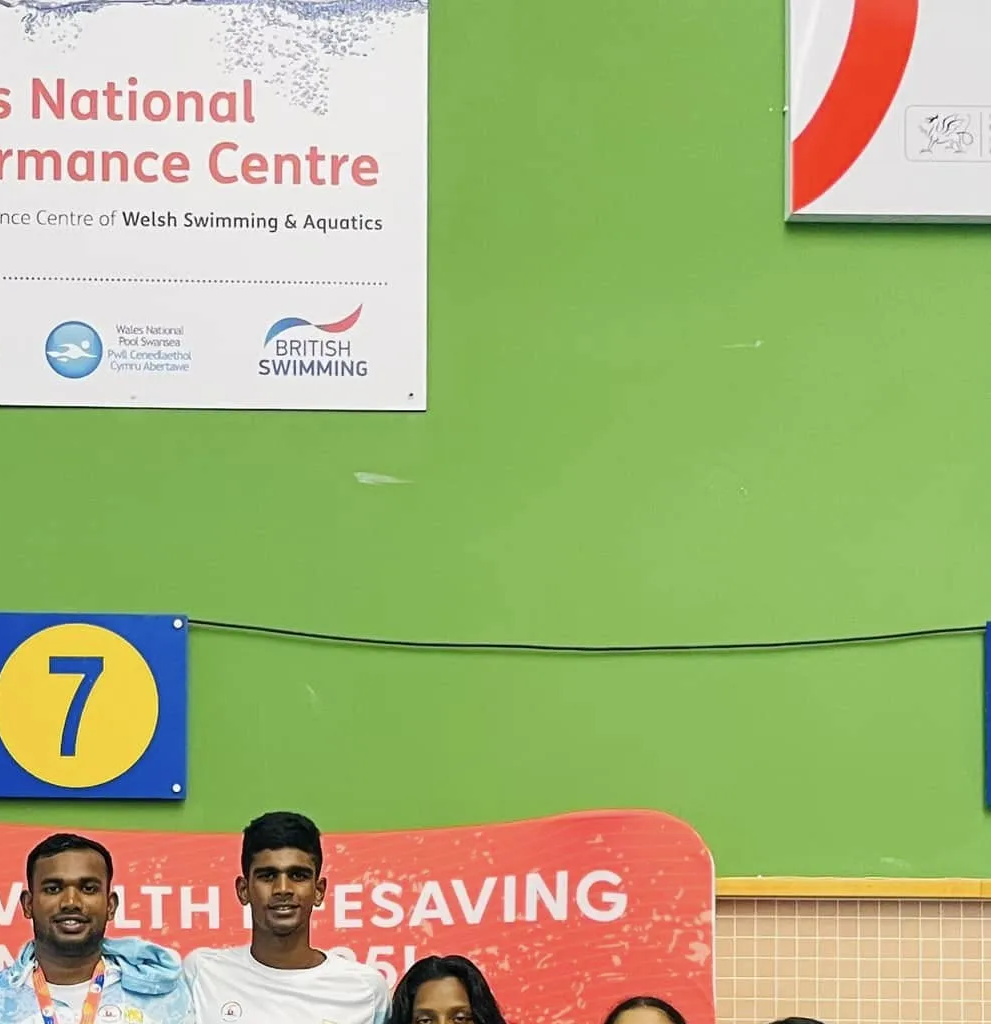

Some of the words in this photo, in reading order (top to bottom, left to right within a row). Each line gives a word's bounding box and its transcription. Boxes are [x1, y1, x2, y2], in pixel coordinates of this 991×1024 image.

[31, 77, 256, 123] National
[208, 141, 380, 187] Centre
[36, 209, 94, 227] Centre
[99, 209, 118, 227] of
[122, 210, 178, 228] Welsh
[183, 211, 278, 233] Swimming
[284, 214, 298, 230] &
[303, 213, 383, 235] Aquatics
[115, 324, 144, 335] Wales
[146, 325, 184, 336] National
[118, 336, 139, 347] Pool
[141, 336, 181, 347] Swansea
[275, 340, 351, 357] BRITISH
[110, 360, 141, 372] Cymru
[143, 361, 190, 372] Abertawe
[258, 359, 368, 377] SWIMMING
[49, 655, 105, 757] 7
[243, 869, 628, 929] ESAVING
